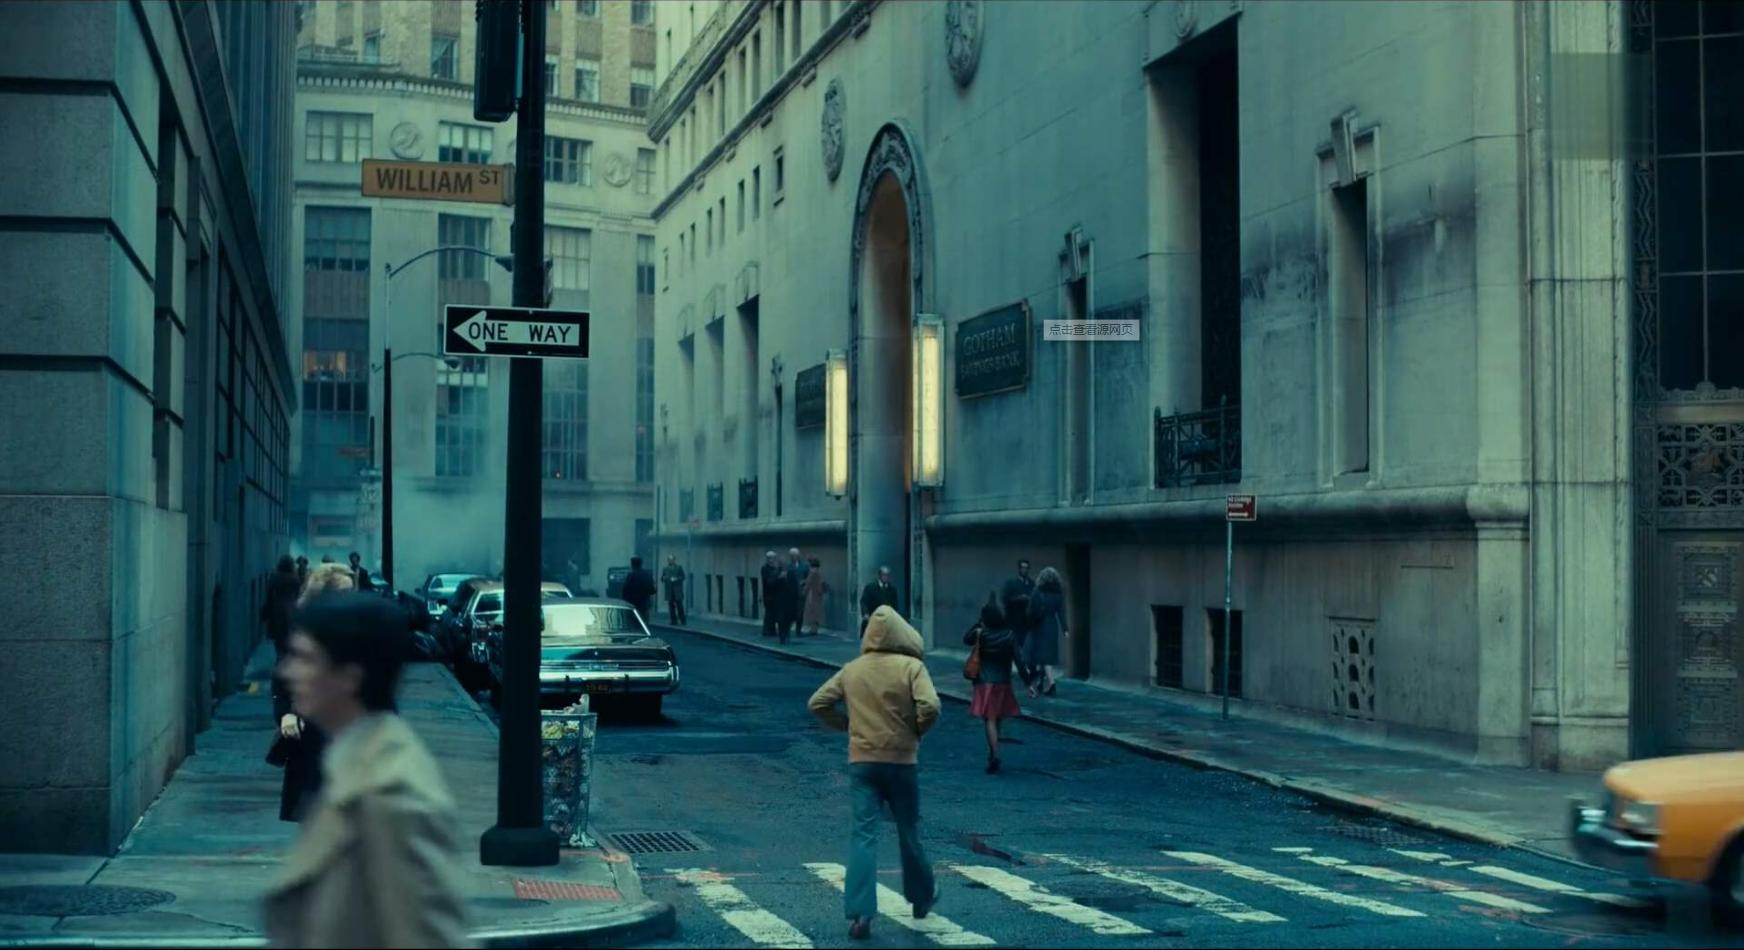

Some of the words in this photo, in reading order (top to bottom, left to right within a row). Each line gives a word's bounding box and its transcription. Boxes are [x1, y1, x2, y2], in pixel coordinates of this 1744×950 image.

[377, 168, 473, 194] WILLIAM
[479, 170, 499, 185] ST
[468, 322, 508, 341] ONE
[529, 324, 571, 343] WAY
[963, 322, 1016, 356] GOTHAM
